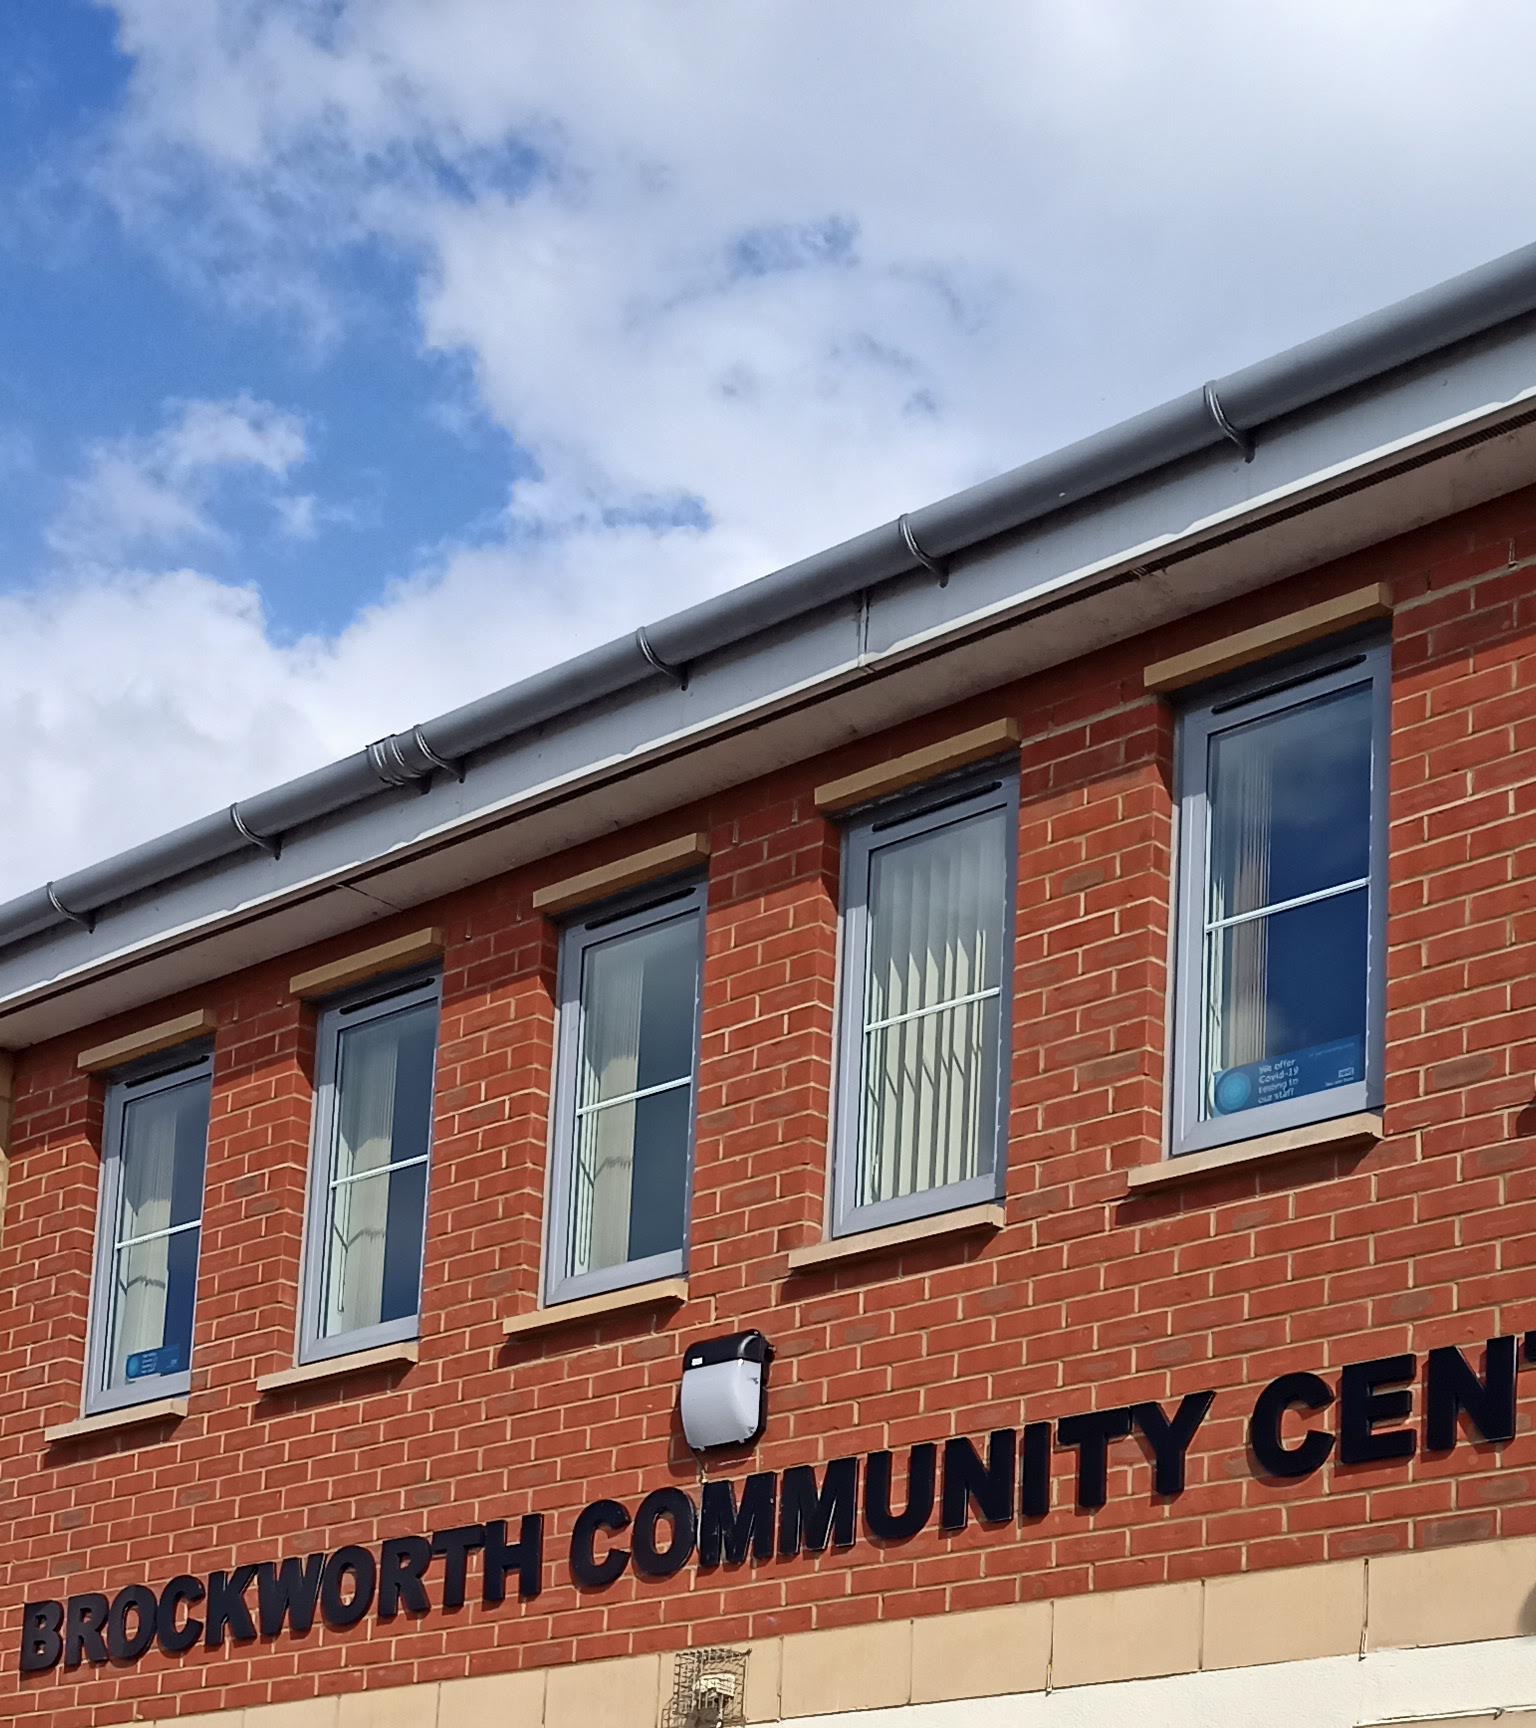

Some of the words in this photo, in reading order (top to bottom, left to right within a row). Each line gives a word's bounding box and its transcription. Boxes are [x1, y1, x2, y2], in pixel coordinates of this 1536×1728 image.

[1259, 1066, 1299, 1083] Covid-19
[20, 1514, 544, 1672] BROCKWORTH
[570, 1391, 1216, 1587] COMMUNITY
